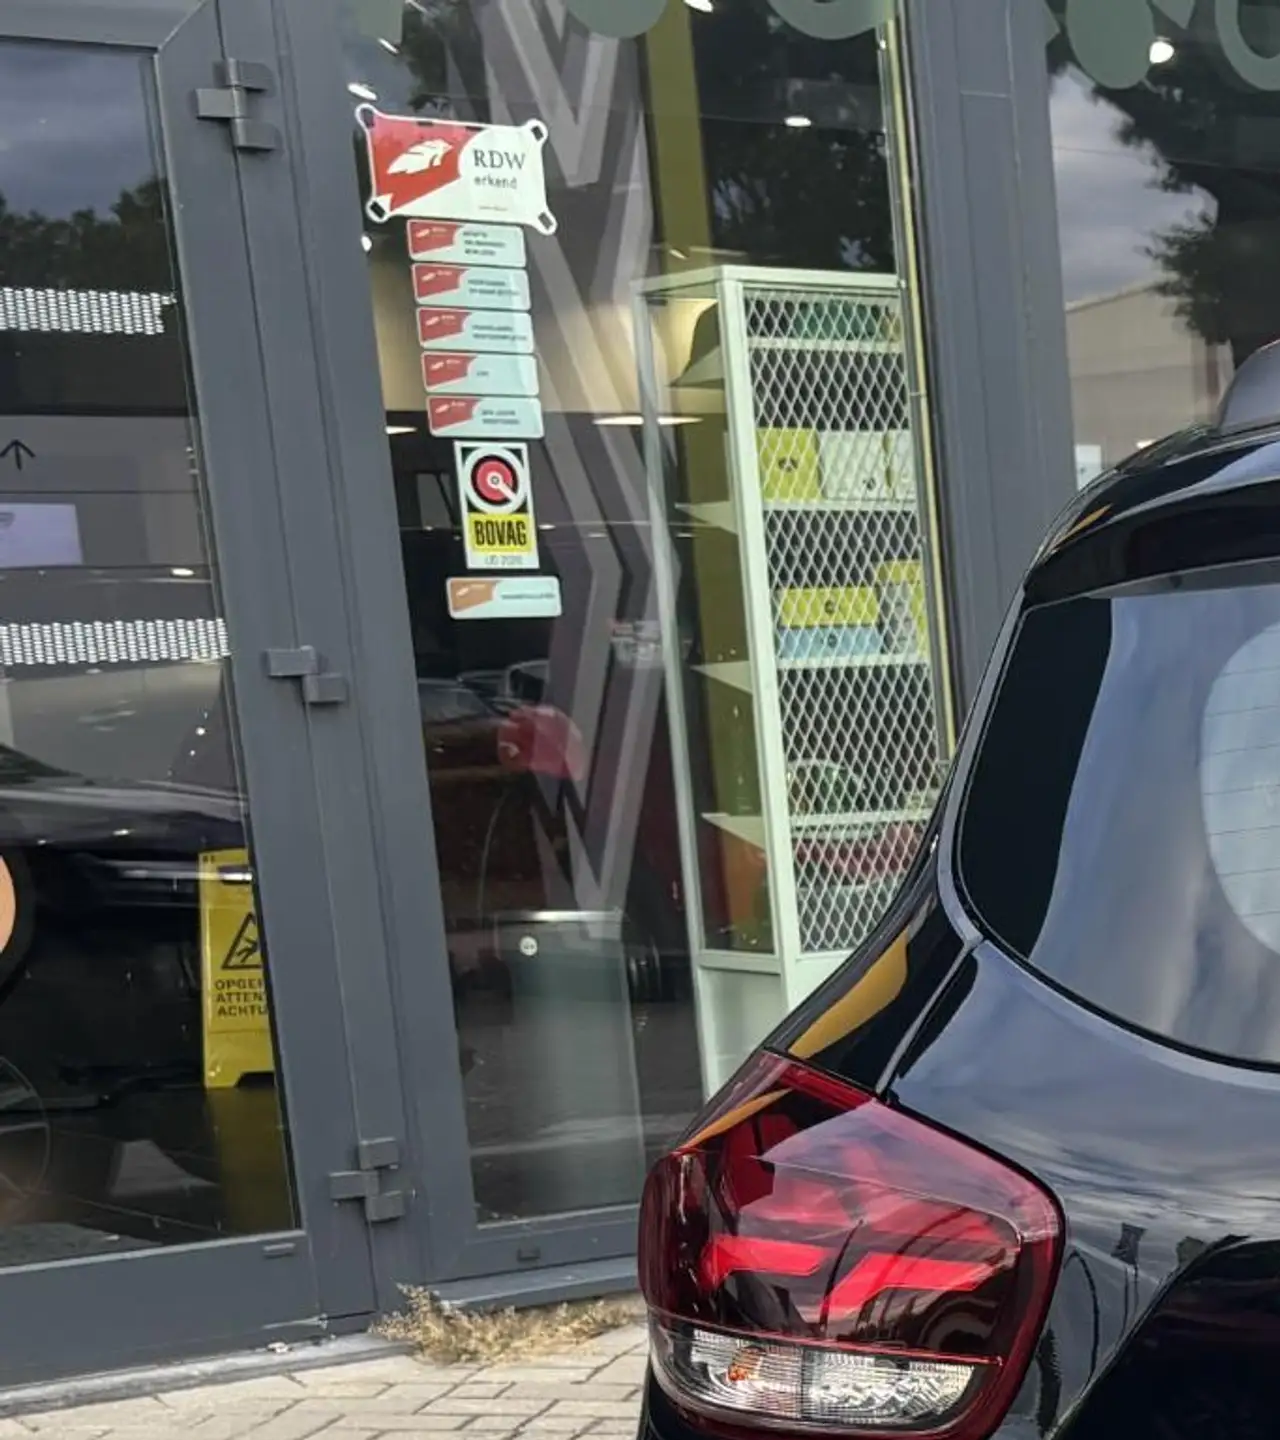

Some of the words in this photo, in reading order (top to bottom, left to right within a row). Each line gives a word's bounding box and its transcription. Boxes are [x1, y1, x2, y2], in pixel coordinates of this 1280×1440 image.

[473, 149, 526, 170] RDW
[474, 173, 518, 190] erkend
[474, 519, 528, 546] BOVAG
